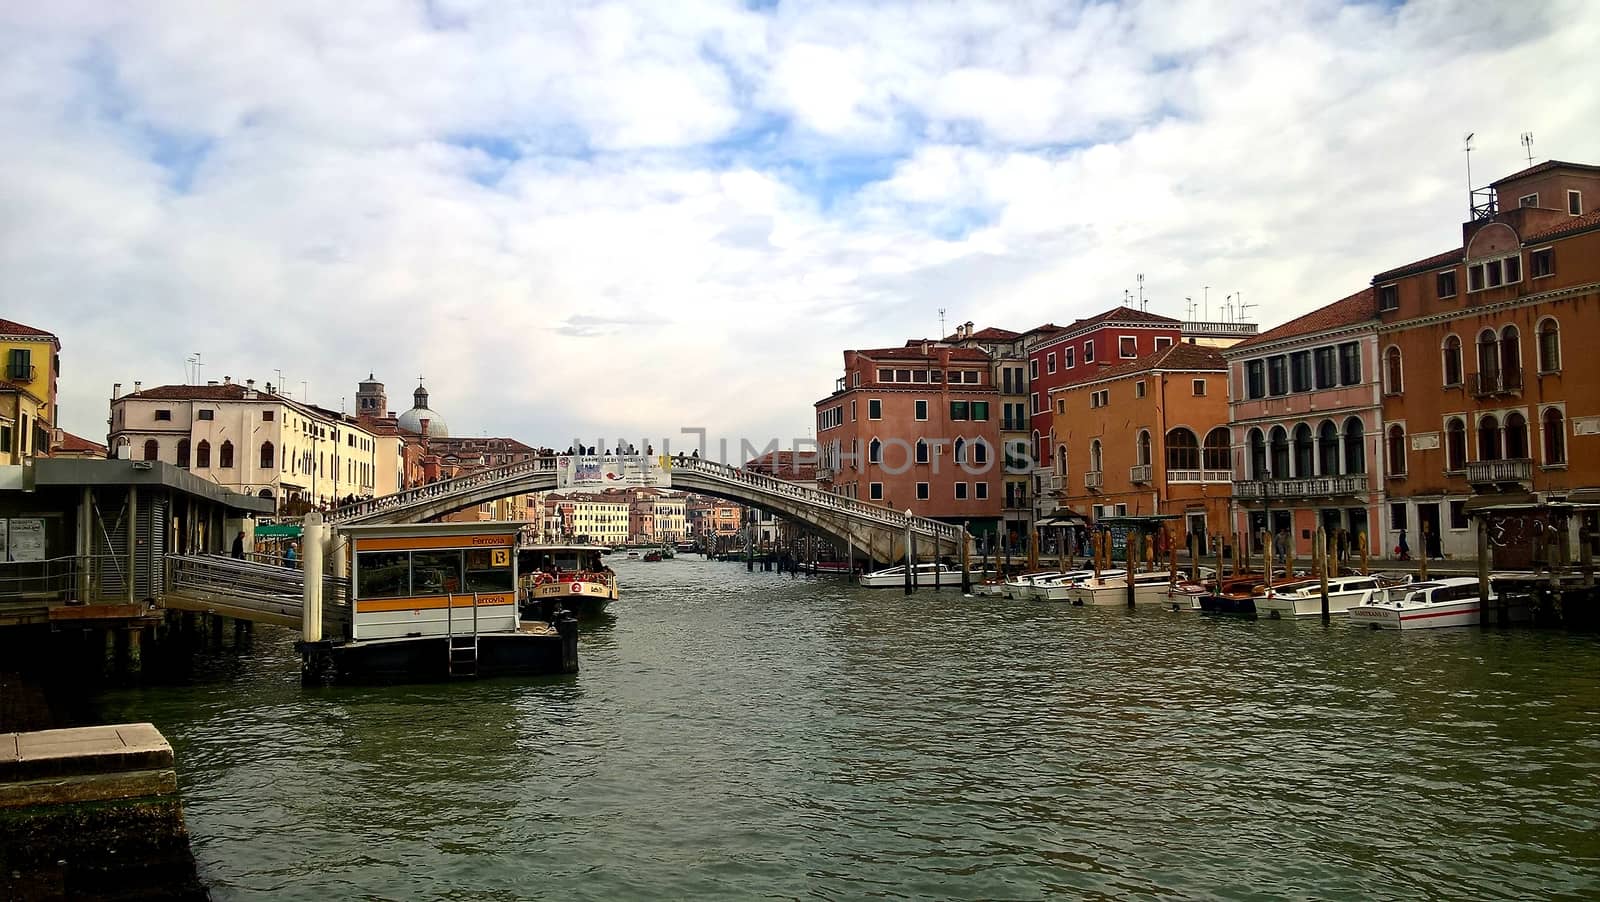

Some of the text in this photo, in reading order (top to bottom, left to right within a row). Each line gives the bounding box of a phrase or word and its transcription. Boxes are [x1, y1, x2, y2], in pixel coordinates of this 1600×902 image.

[472, 536, 505, 545] Ferrovia
[495, 551, 506, 564] B
[477, 595, 505, 604] errovia
